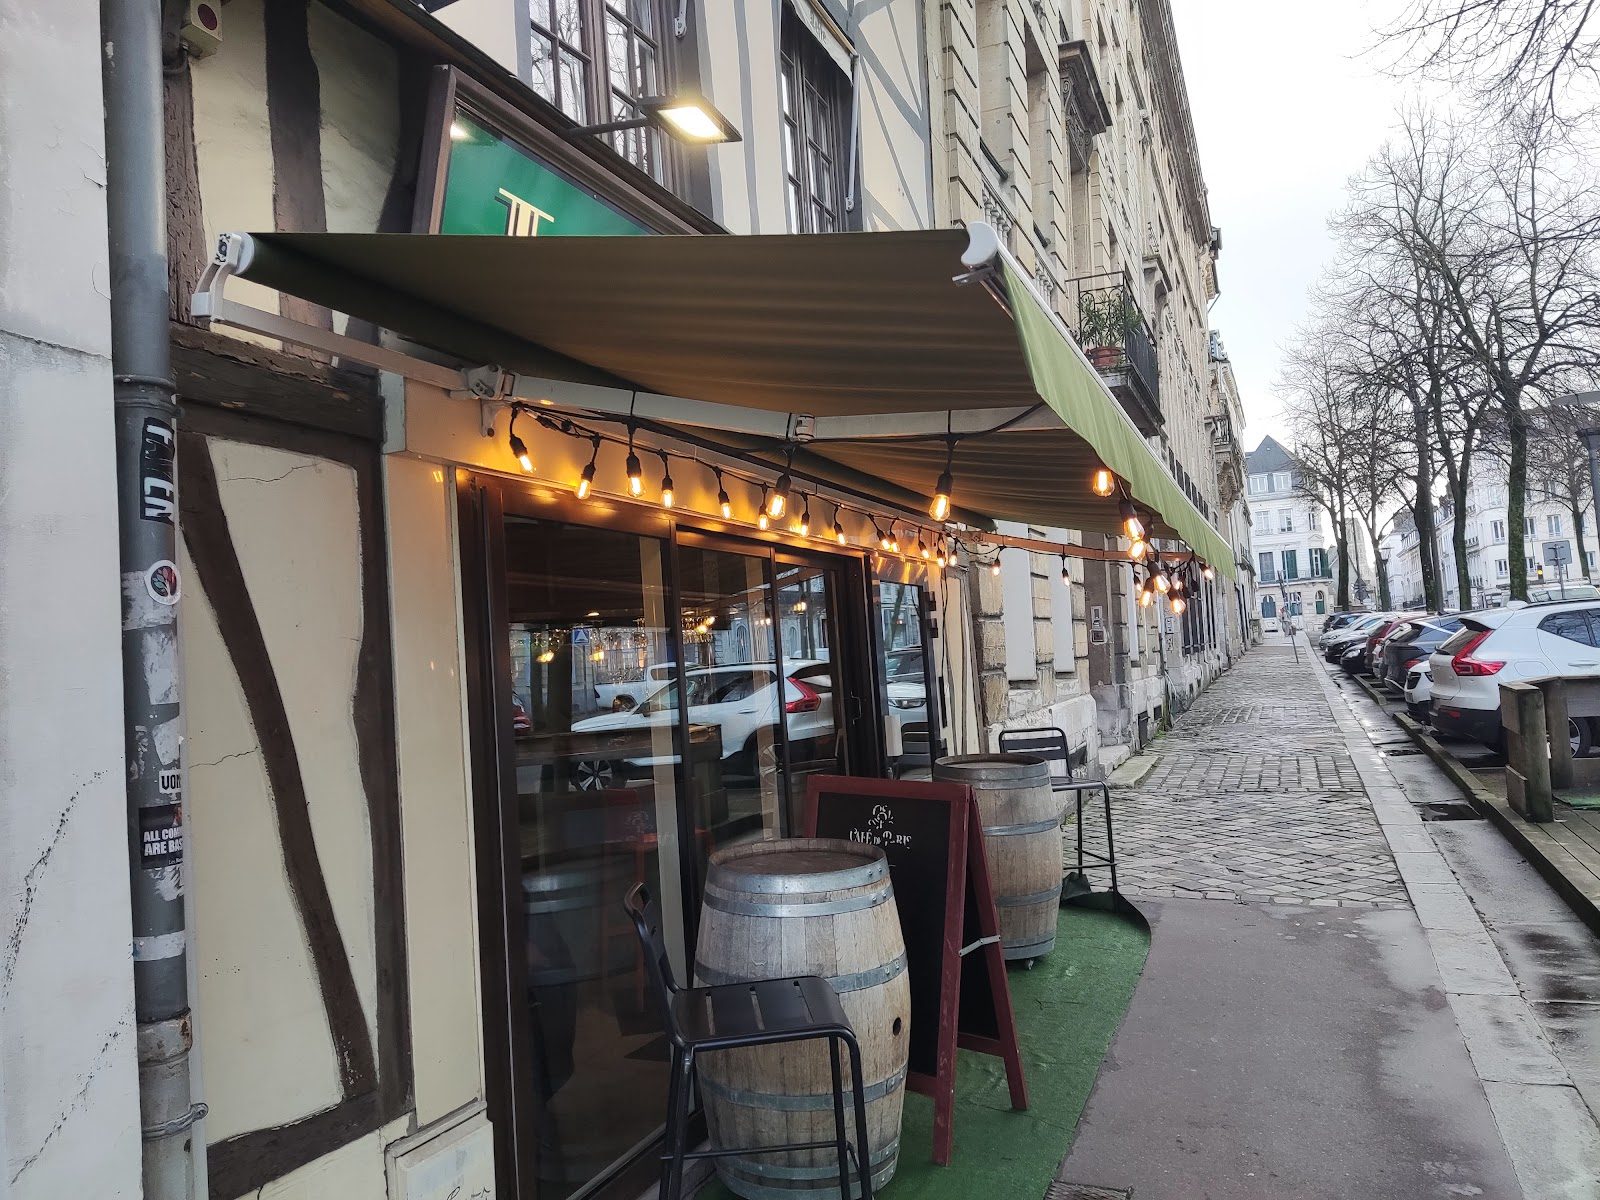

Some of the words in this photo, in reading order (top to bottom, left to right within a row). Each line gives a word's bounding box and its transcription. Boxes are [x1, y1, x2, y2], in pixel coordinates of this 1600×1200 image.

[144, 830, 160, 842] ALL
[882, 831, 911, 849] PRIS
[144, 841, 167, 856] ARE
